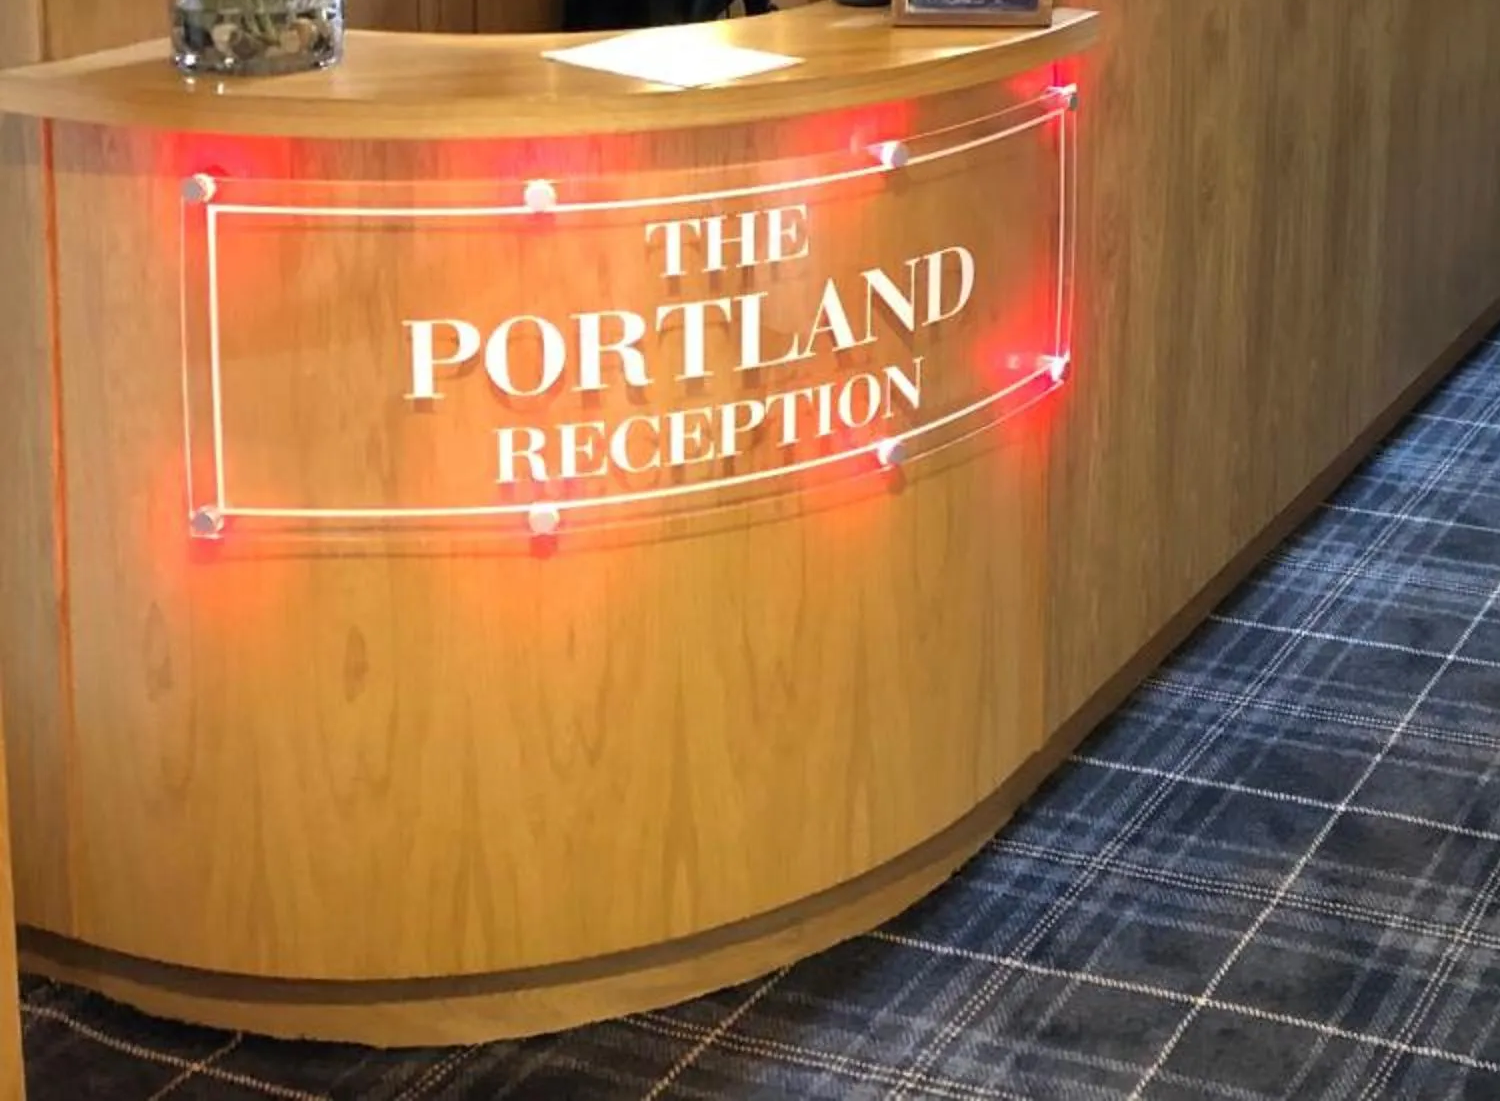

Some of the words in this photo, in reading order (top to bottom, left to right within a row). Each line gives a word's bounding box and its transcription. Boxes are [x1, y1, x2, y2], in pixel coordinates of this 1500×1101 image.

[644, 205, 809, 277] THE
[402, 245, 976, 400] PORTLAND
[495, 357, 924, 484] RECEPTION
